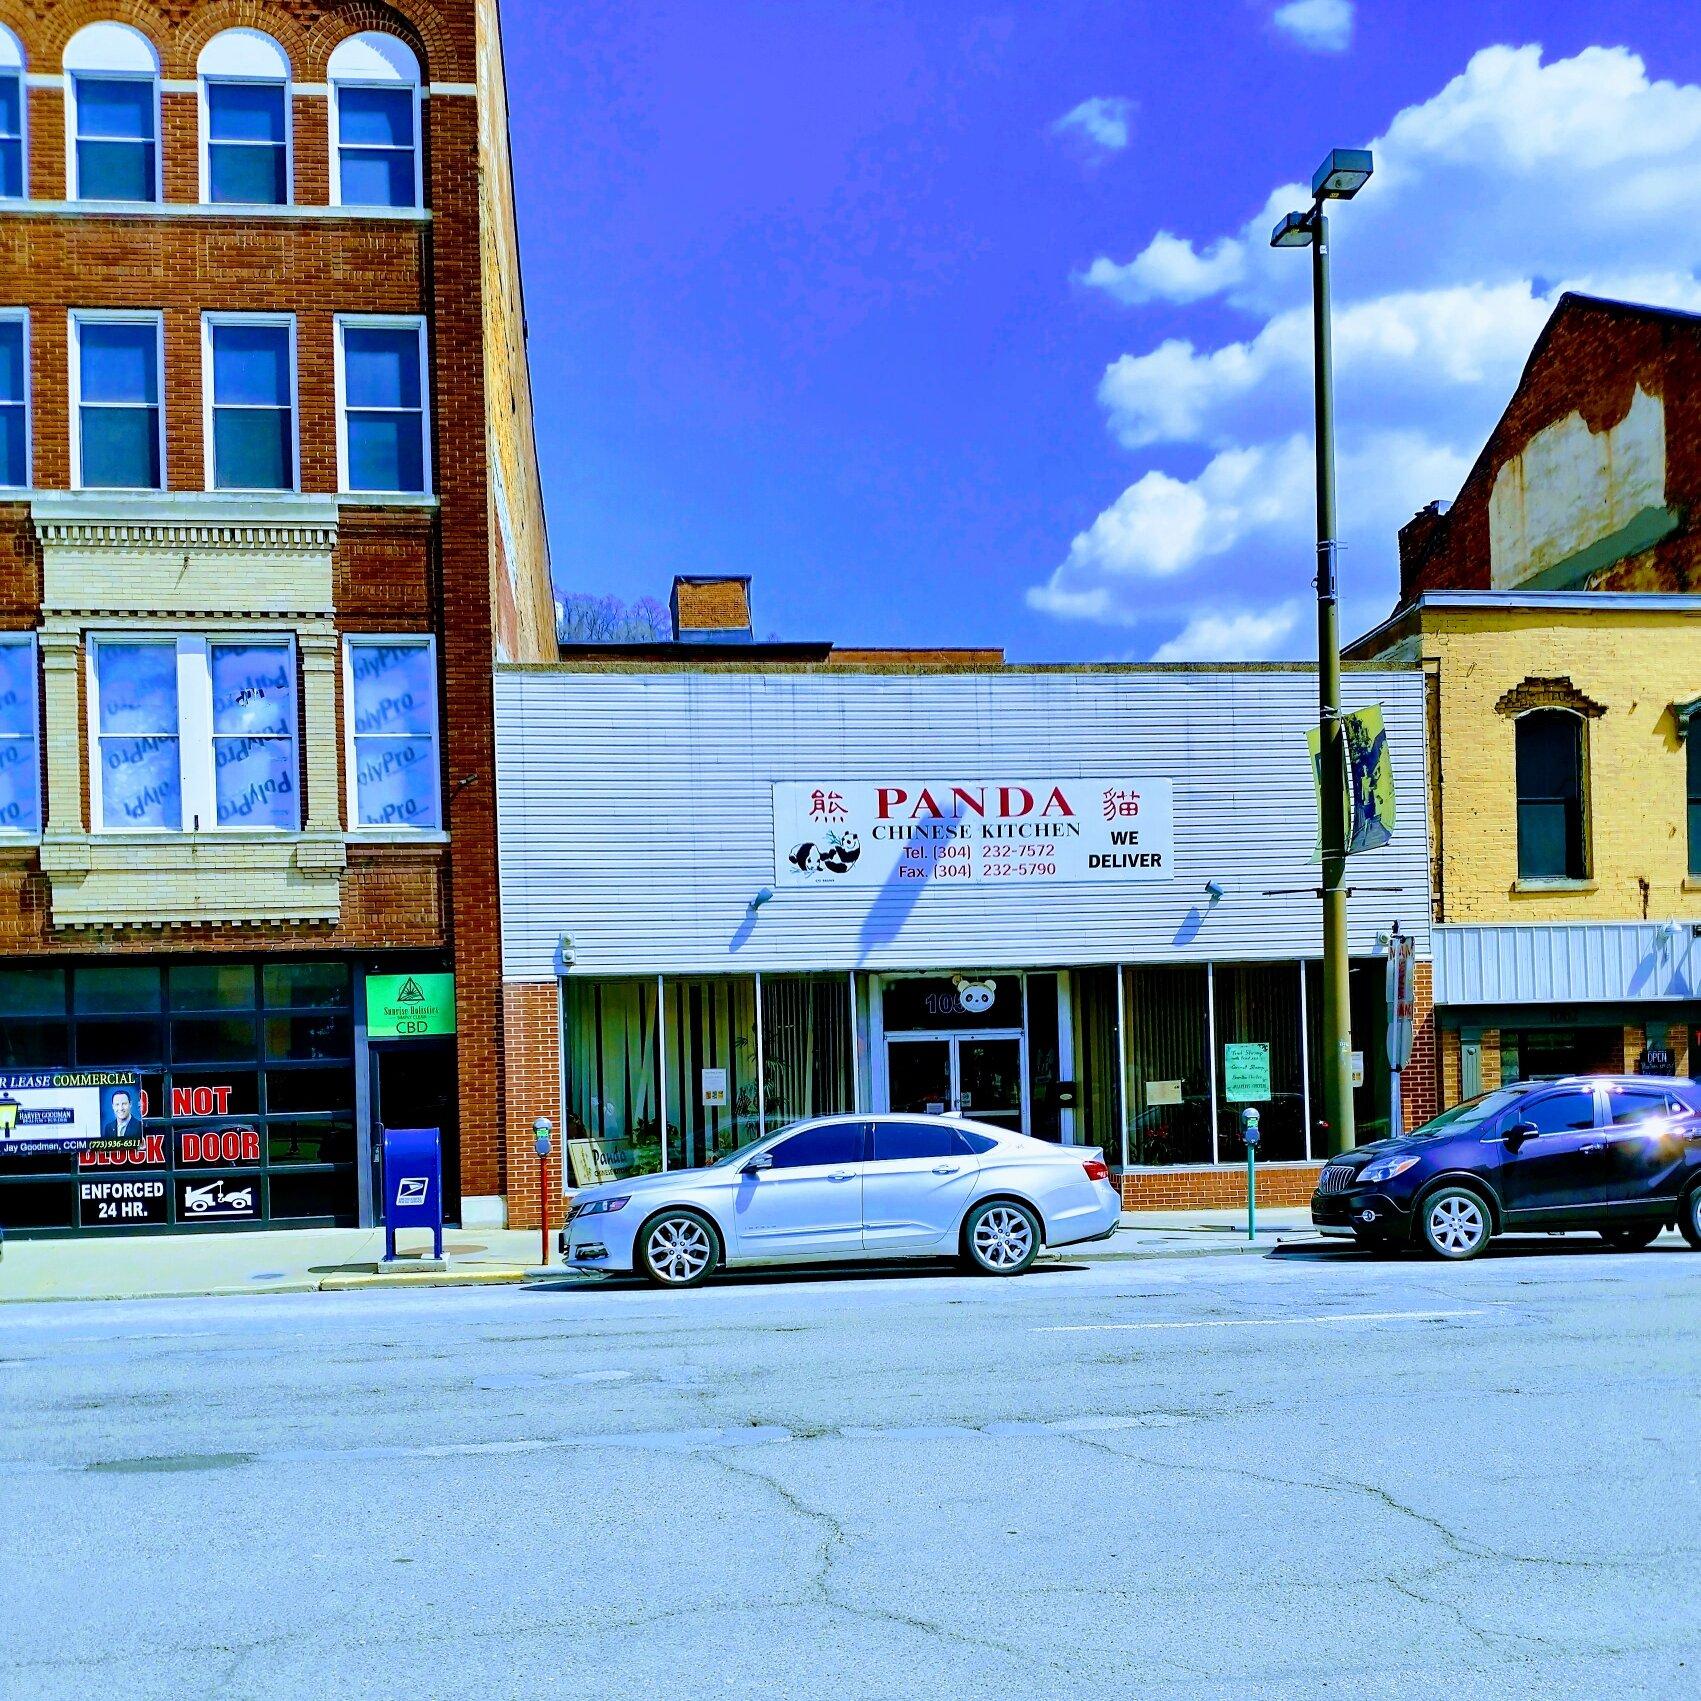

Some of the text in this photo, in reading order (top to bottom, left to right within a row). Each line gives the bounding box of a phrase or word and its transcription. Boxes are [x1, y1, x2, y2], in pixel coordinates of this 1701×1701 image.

[872, 785, 1077, 820] PANDA
[872, 822, 1080, 840] CHINESE KITCHEN
[1111, 831, 1139, 846] WE
[902, 843, 1055, 860] Tel. (304) 232-7572
[1088, 852, 1162, 868] DELIVER
[899, 863, 1056, 879] Fax. (304) 232-5790
[396, 1021, 428, 1033] CBD
[1648, 1051, 1668, 1063] OPEN
[10, 1075, 51, 1088] LEASE
[53, 1072, 136, 1087] COMMERCIAL
[172, 1086, 232, 1116] NOT
[4, 1143, 18, 1153] Jay
[20, 1142, 61, 1152] Goodman,
[63, 1140, 87, 1149] CCIM
[181, 1131, 260, 1163] DOOR
[592, 1146, 626, 1167] Panda
[81, 1182, 164, 1200] ENFORCED
[99, 1201, 148, 1218] 24 HR.
